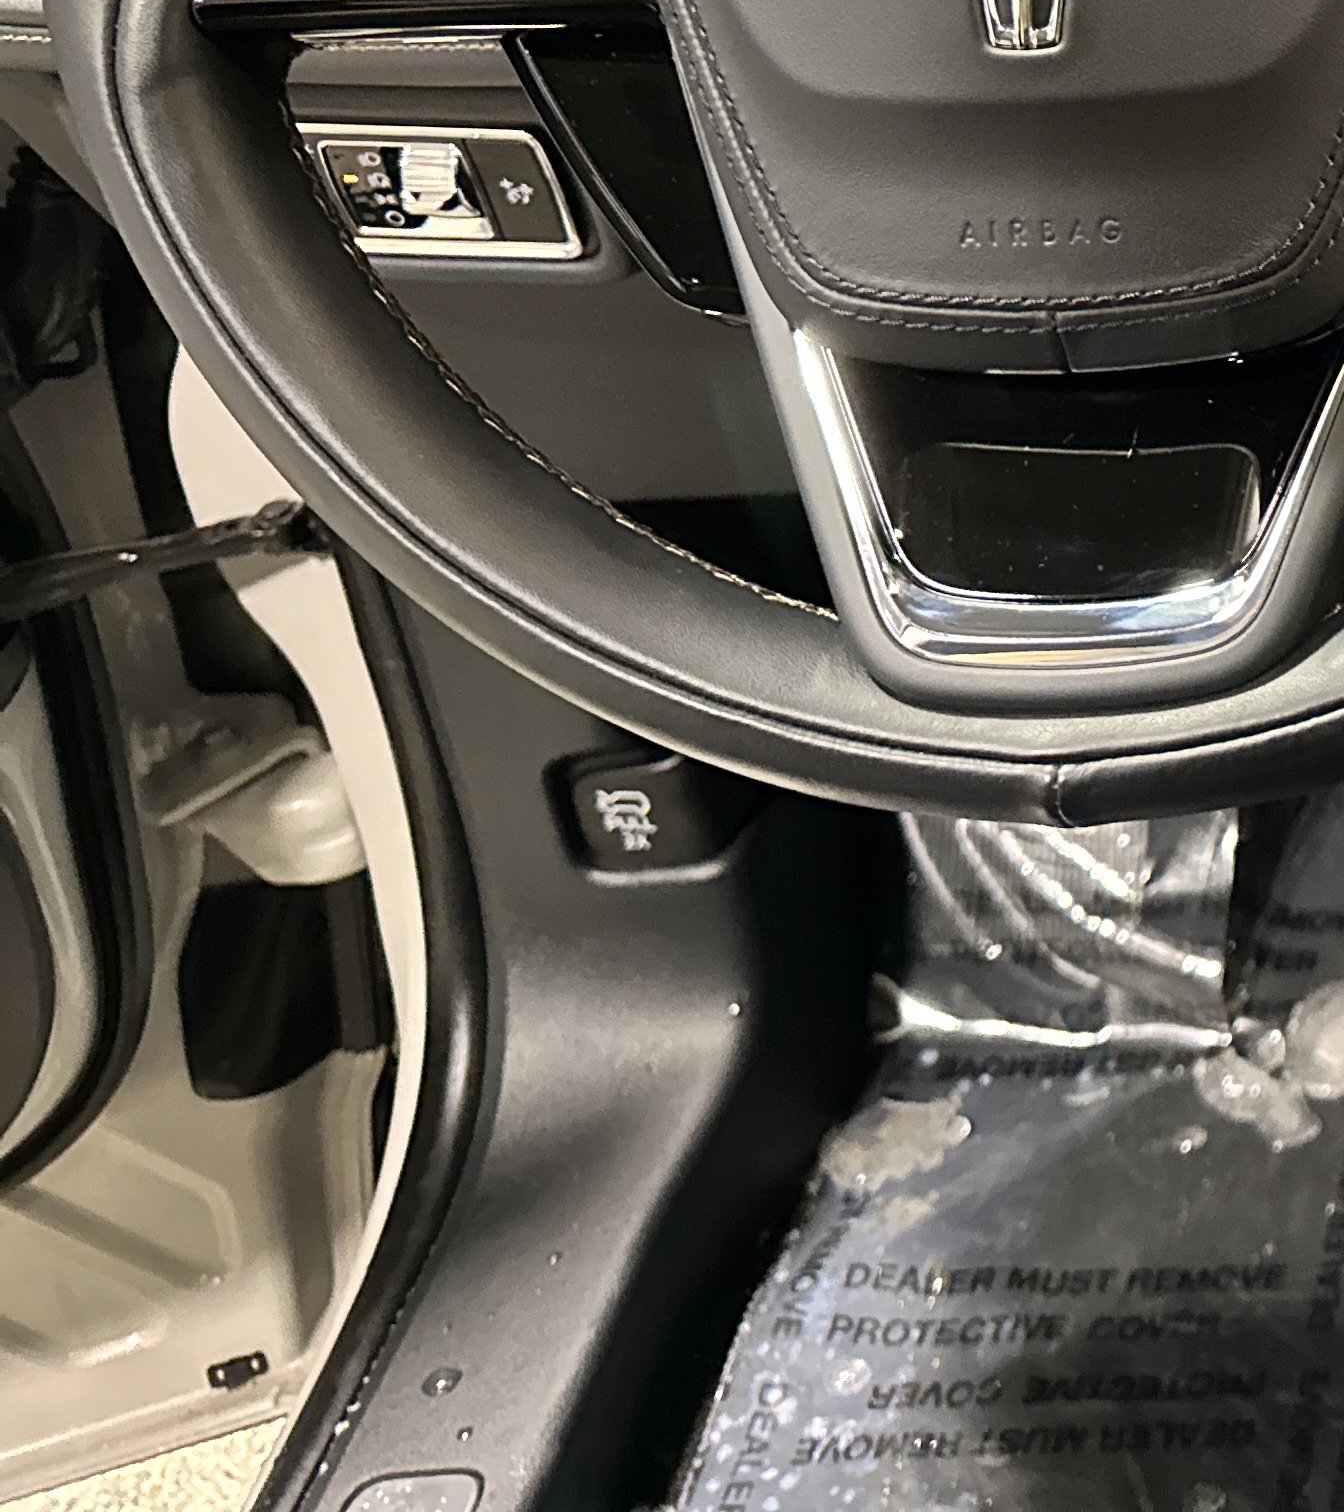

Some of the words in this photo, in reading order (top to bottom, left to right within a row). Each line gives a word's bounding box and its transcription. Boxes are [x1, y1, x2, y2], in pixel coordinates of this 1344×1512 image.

[958, 215, 1123, 249] AIRBAG
[843, 1261, 997, 1297] DEALER
[1006, 1264, 1121, 1296] MUST
[1125, 1261, 1288, 1293] REMOVE
[824, 1311, 1070, 1348] PROTECTIVE
[867, 1375, 1005, 1410] COVER
[789, 1429, 962, 1467] REMOVE
[974, 1421, 1090, 1457] MUST
